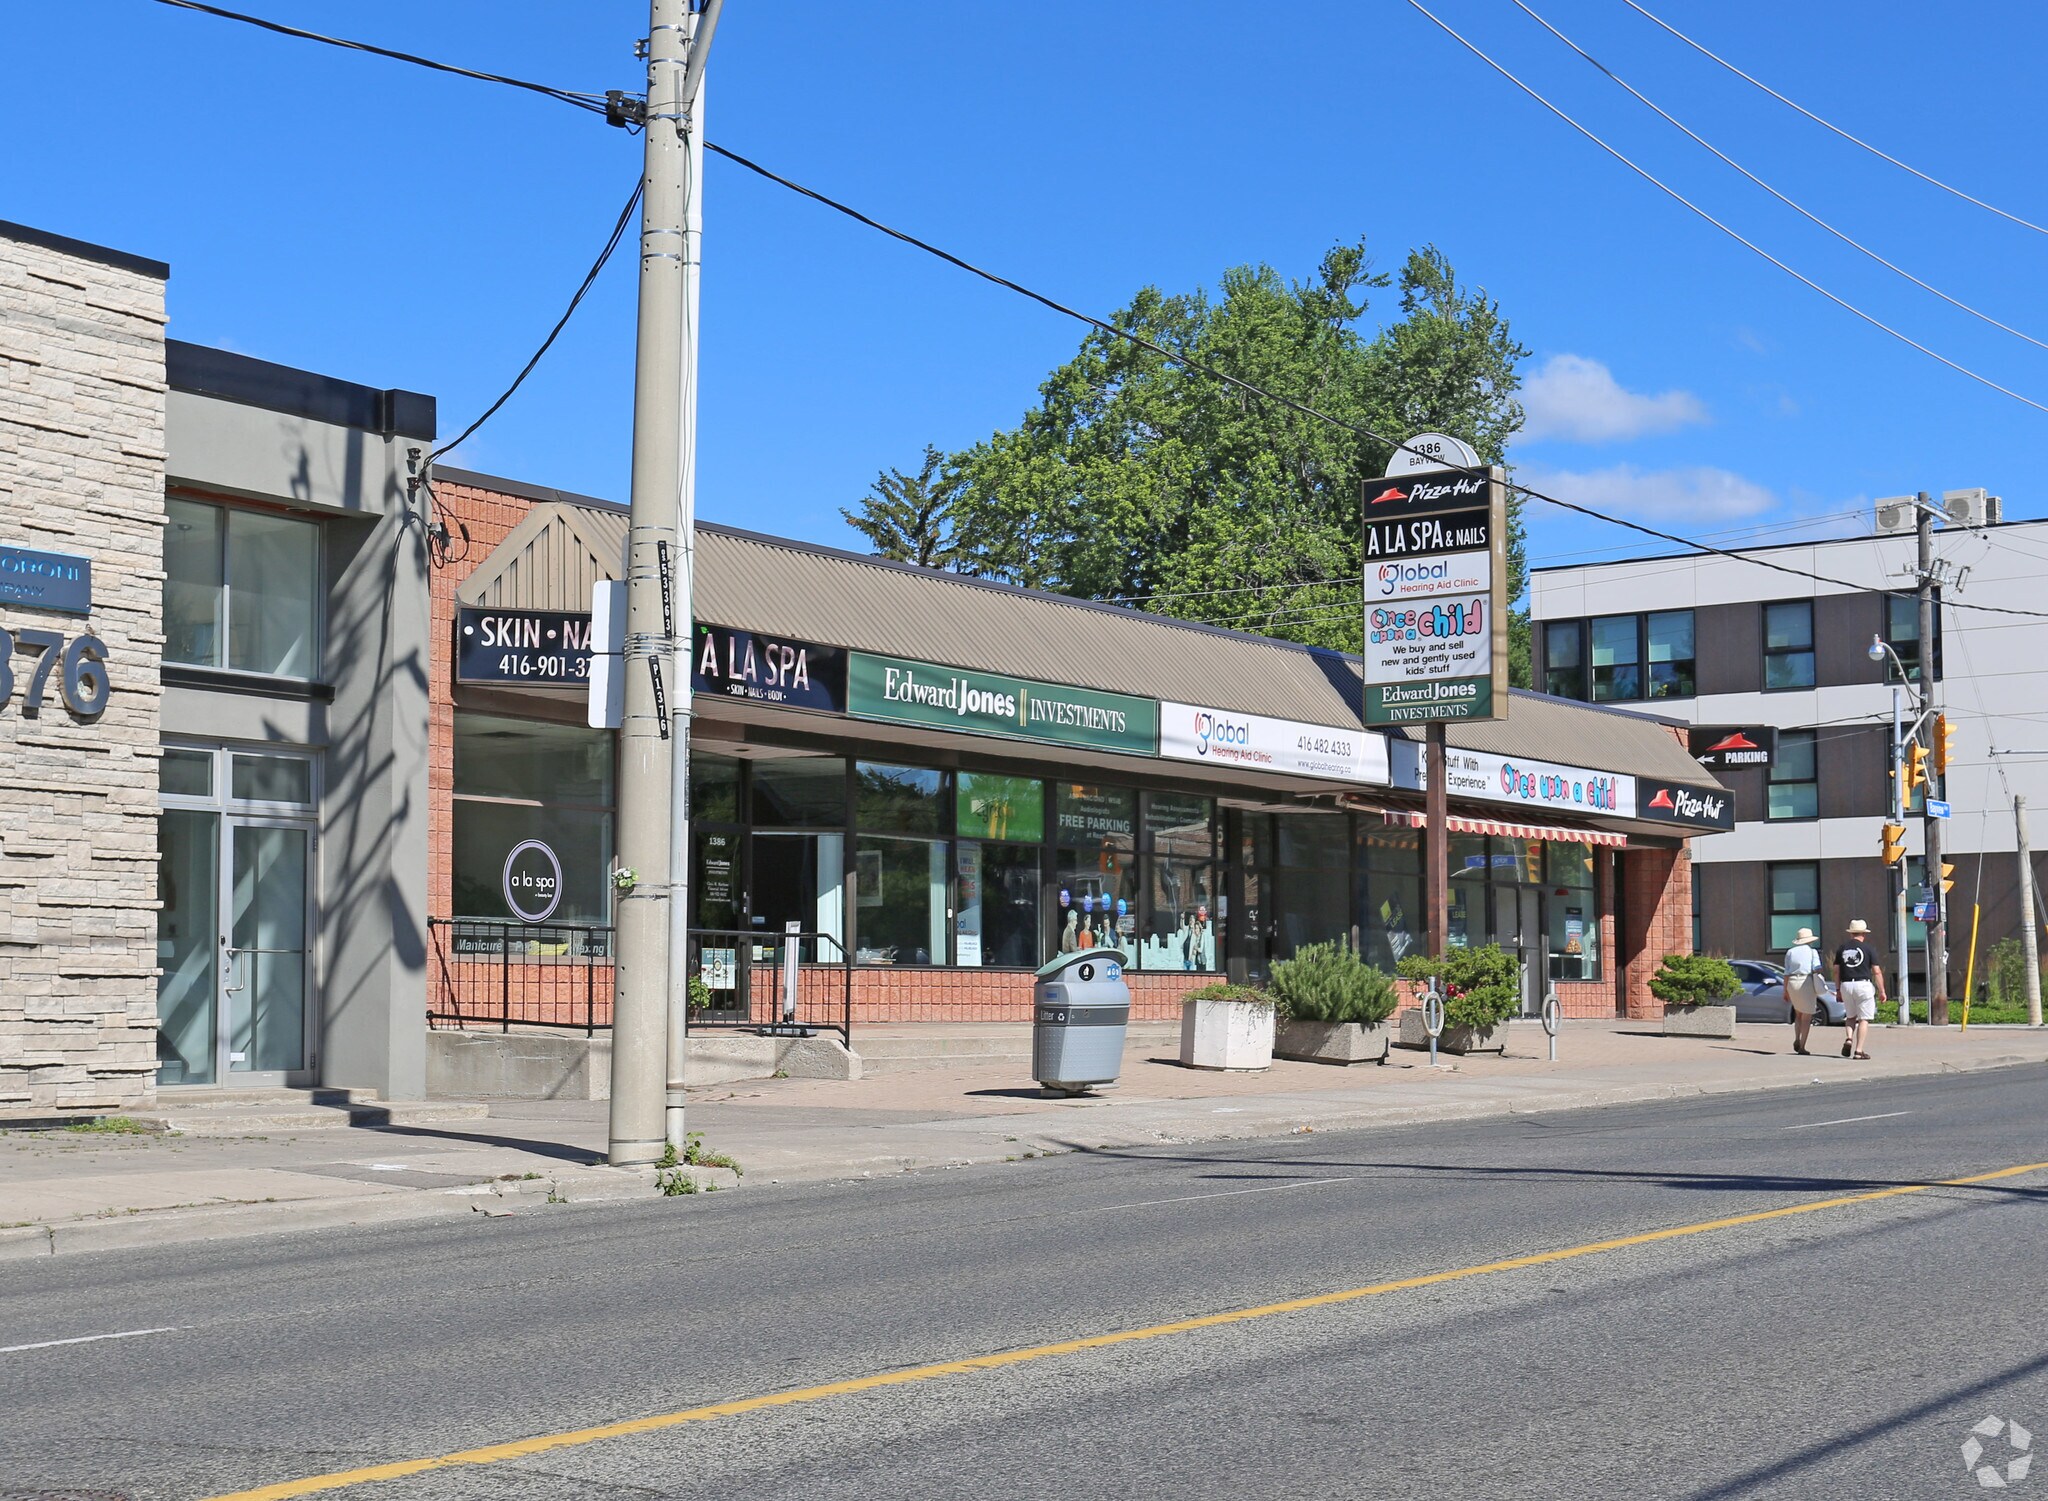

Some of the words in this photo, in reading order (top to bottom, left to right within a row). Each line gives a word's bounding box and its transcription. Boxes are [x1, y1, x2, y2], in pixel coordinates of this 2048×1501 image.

[1413, 442, 1441, 455] 1386
[1408, 482, 1451, 503] Pizza
[1451, 478, 1486, 496] Hut
[1367, 527, 1380, 555] A
[1385, 524, 1406, 553] LA
[1411, 520, 1443, 551] SPA
[1445, 530, 1454, 547] &
[1456, 527, 1486, 546] NAILS
[0, 582, 45, 597] PANY
[1400, 582, 1434, 593] Hearing
[1437, 580, 1451, 590] Aid
[1454, 578, 1479, 588] Clinic
[1370, 608, 1416, 629] Once
[1417, 599, 1482, 638] child
[481, 616, 541, 649] SKIN
[1370, 628, 1404, 644] upon
[1405, 628, 1416, 640] a
[1393, 646, 1406, 654] We
[1409, 645, 1426, 654] buy
[1429, 642, 1446, 651] and
[1448, 641, 1464, 650] sell
[700, 633, 719, 677] A
[729, 636, 757, 682] LA
[765, 643, 810, 691] SPA
[1382, 659, 1400, 667] new
[1403, 656, 1419, 665] and
[1422, 653, 1450, 665] gently
[1452, 651, 1475, 660] used
[0, 626, 110, 714] 76
[1406, 666, 1426, 675] kids'
[1429, 664, 1450, 673] stuff
[730, 683, 745, 695] SKIN
[748, 686, 763, 699] NAILS
[767, 690, 783, 701] BODY
[1030, 698, 1126, 733] INVESTMENTS
[1390, 704, 1468, 720] INVESTMENTS
[1212, 745, 1239, 762] Hearing
[1240, 749, 1252, 761] Aid
[1253, 751, 1273, 764] Clinic
[1297, 736, 1312, 752] 416
[1314, 738, 1329, 754] 482
[1331, 741, 1351, 757] 4333
[1463, 756, 1479, 771] With
[1725, 751, 1768, 764] PARKING
[1448, 773, 1486, 790] Experience
[1500, 762, 1536, 799] Once
[1540, 774, 1569, 801] upon
[1573, 781, 1583, 803] a
[1587, 776, 1616, 811] child
[1674, 790, 1703, 818] Pizza
[1703, 795, 1725, 819] Hut
[1060, 814, 1085, 828] FREE
[1087, 817, 1130, 833] PARKING
[709, 837, 726, 846] 1386
[511, 876, 519, 886] a
[522, 870, 532, 887] la
[536, 876, 555, 891] spa
[457, 939, 503, 951] Manicure
[1040, 1009, 1055, 1021] Litter
